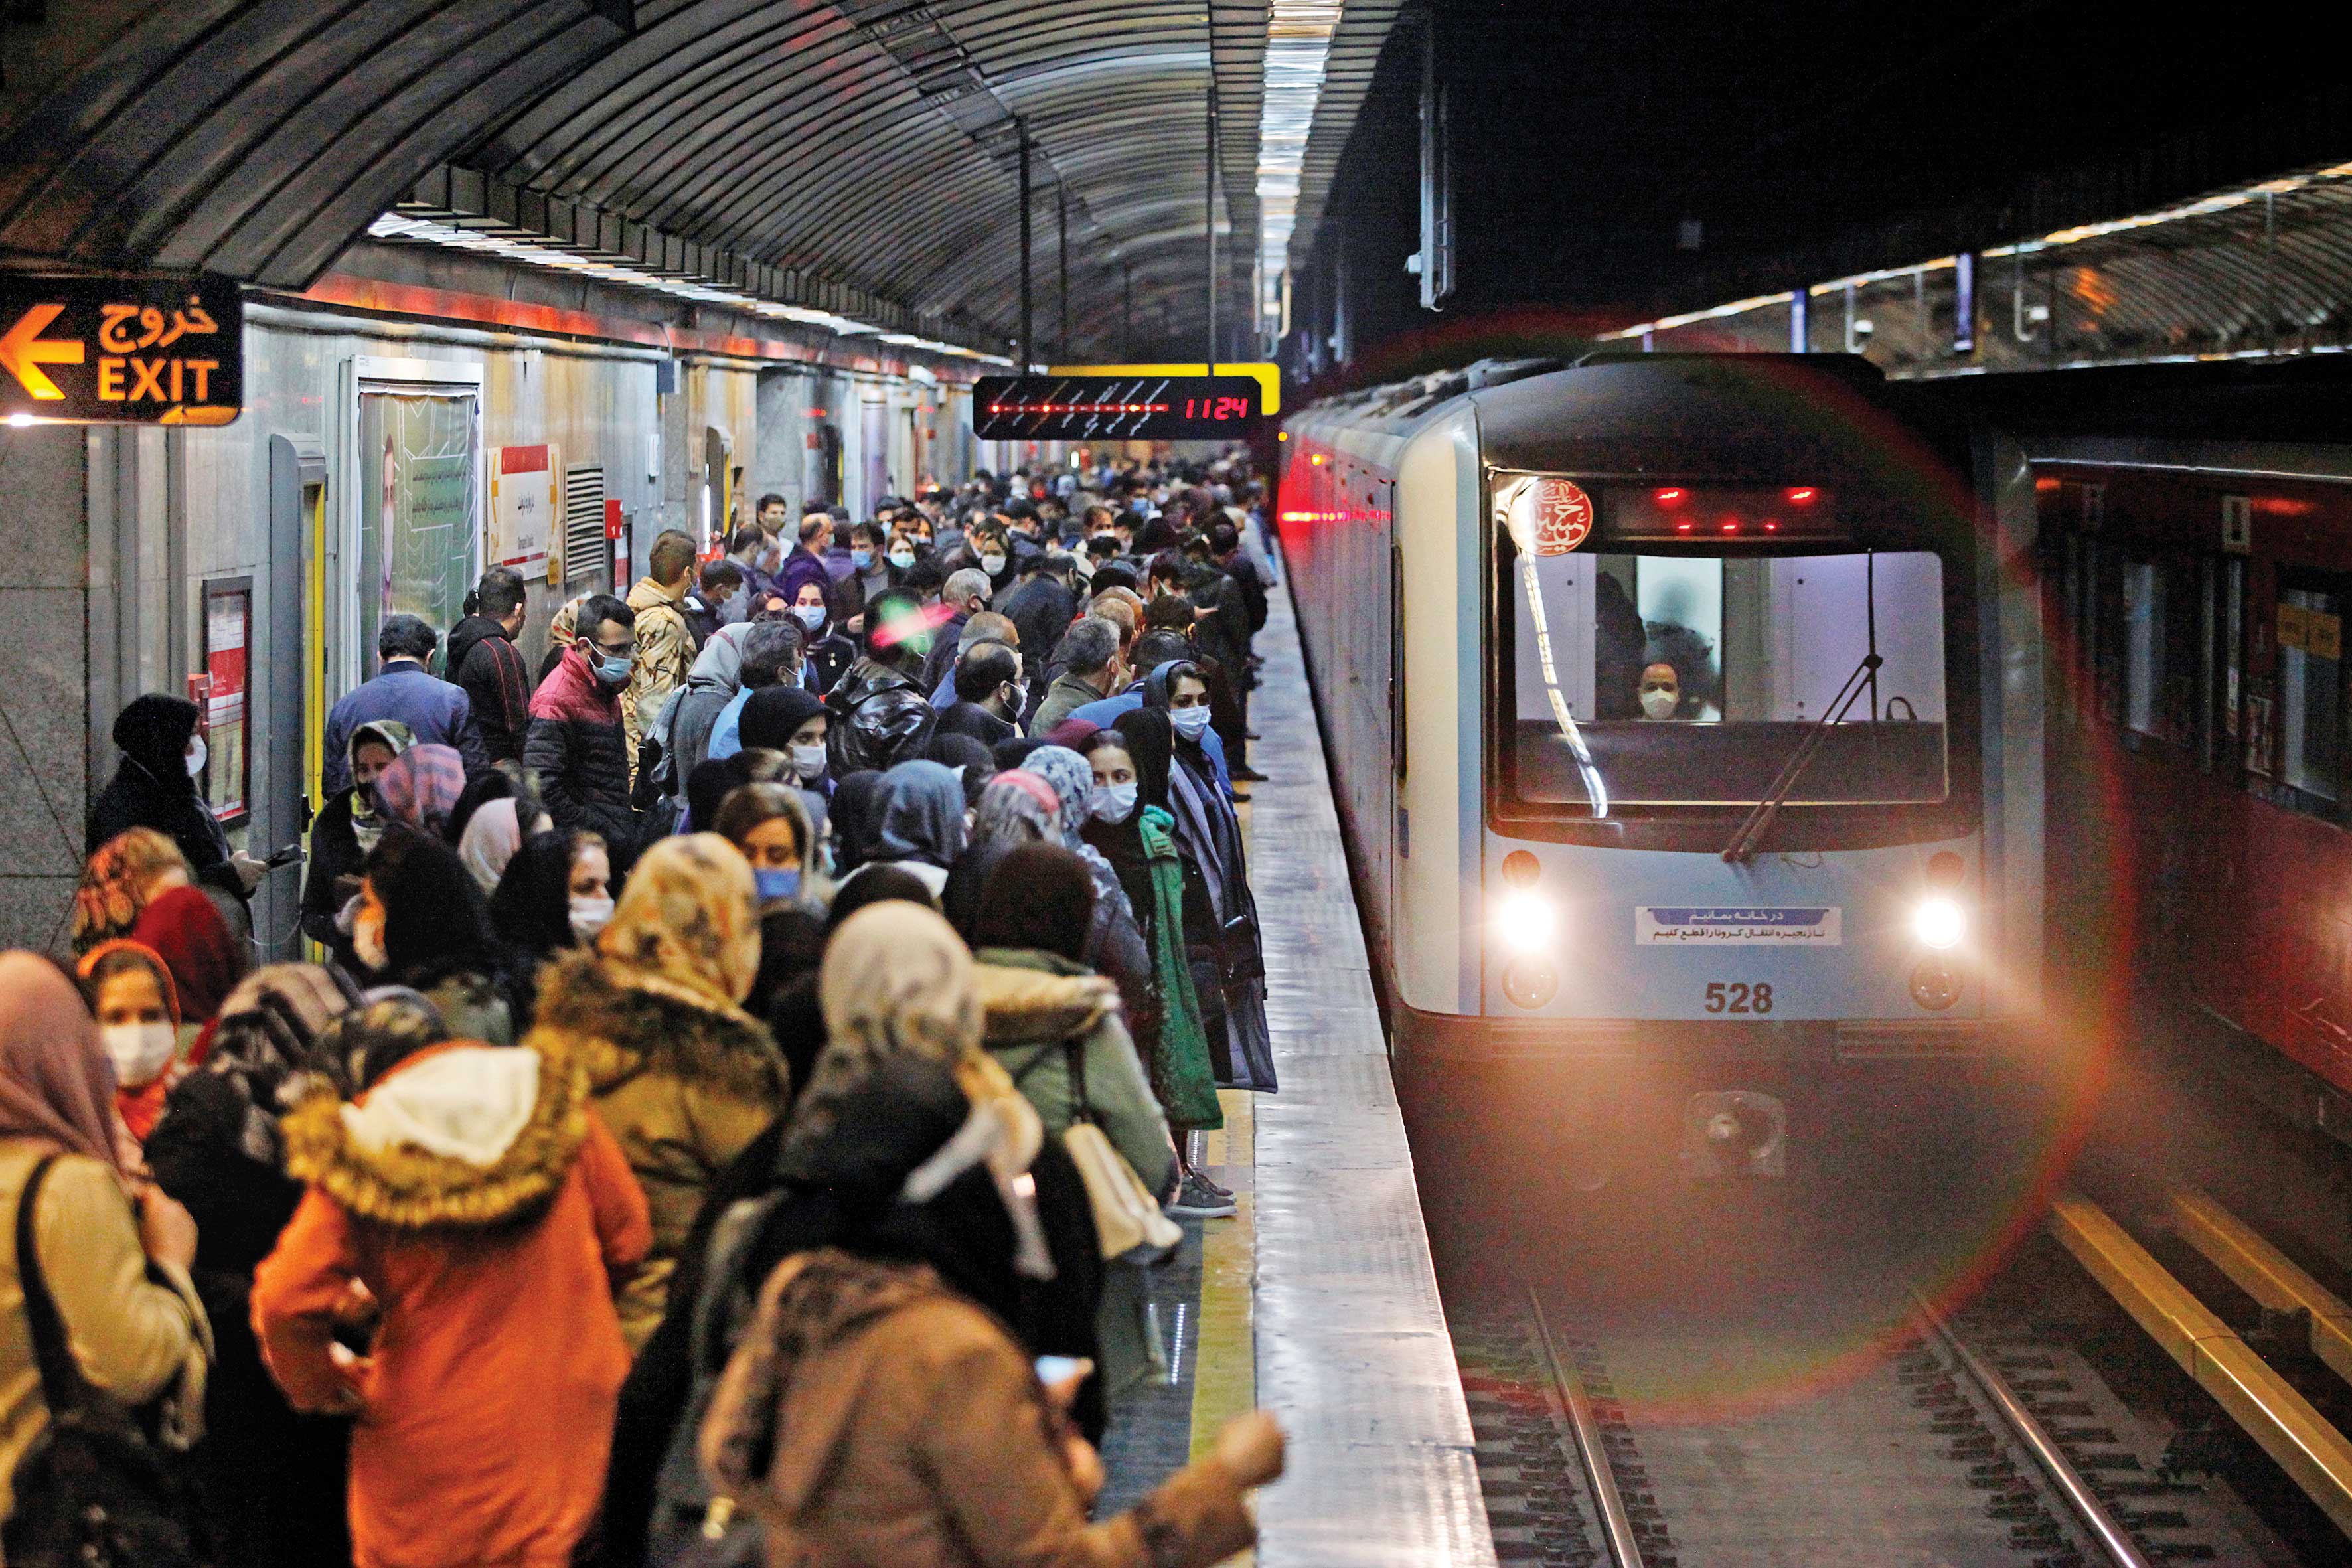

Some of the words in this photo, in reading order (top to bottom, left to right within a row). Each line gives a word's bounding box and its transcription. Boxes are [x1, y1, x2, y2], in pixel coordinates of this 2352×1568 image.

[100, 296, 219, 354] خروج
[98, 358, 220, 402] EXIT
[1689, 910, 1733, 925] بمانیم
[1734, 910, 1767, 920] خانه
[1770, 911, 1784, 921] در
[1653, 928, 1679, 940] کنیم
[1680, 927, 1705, 940] قطع
[1714, 927, 1743, 939] کرونا
[1744, 927, 1774, 939] انتقال
[1704, 982, 1774, 1014] 528
